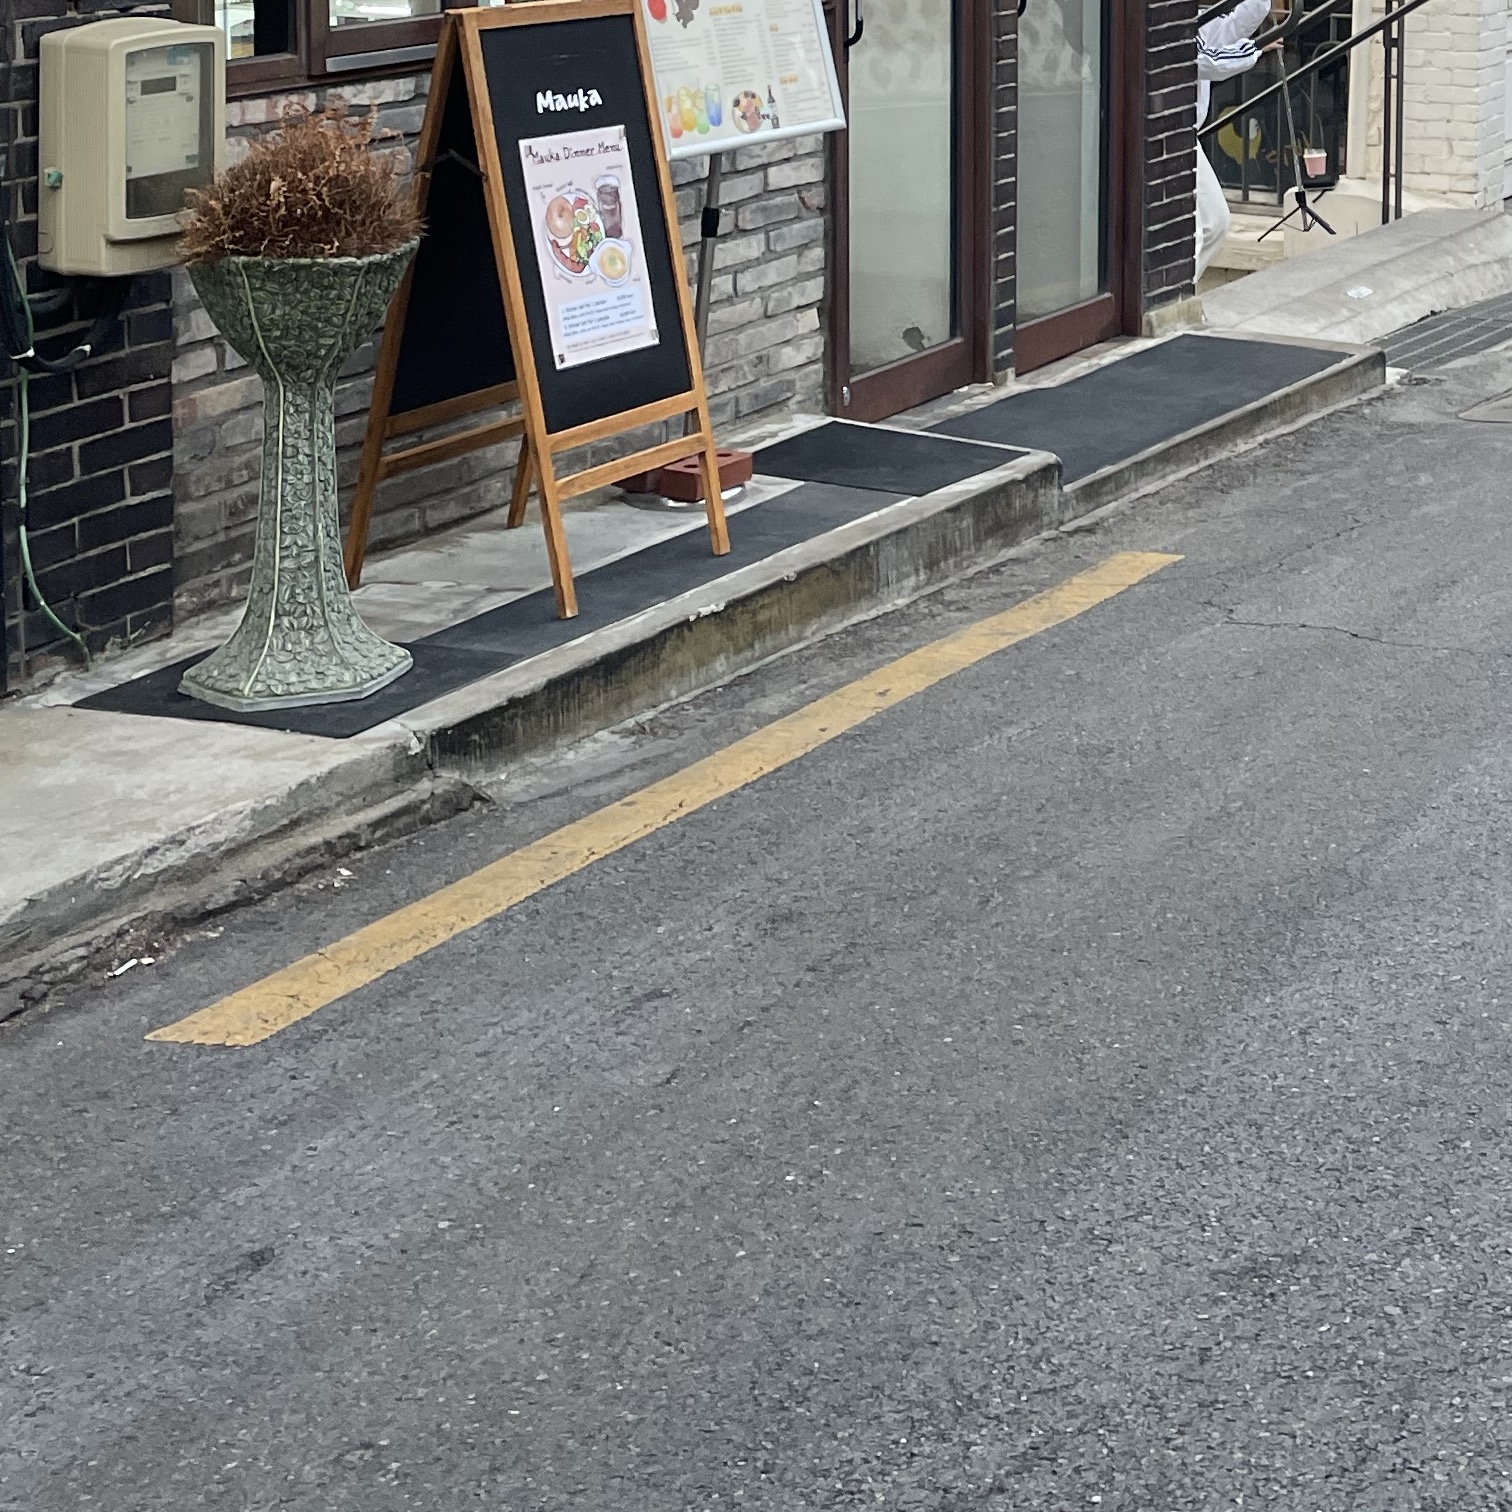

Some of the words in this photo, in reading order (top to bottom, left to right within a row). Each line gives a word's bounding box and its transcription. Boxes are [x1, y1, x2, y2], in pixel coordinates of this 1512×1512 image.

[536, 88, 603, 114] Mauka
[563, 146, 595, 160] Dinner
[597, 141, 622, 155] Menu
